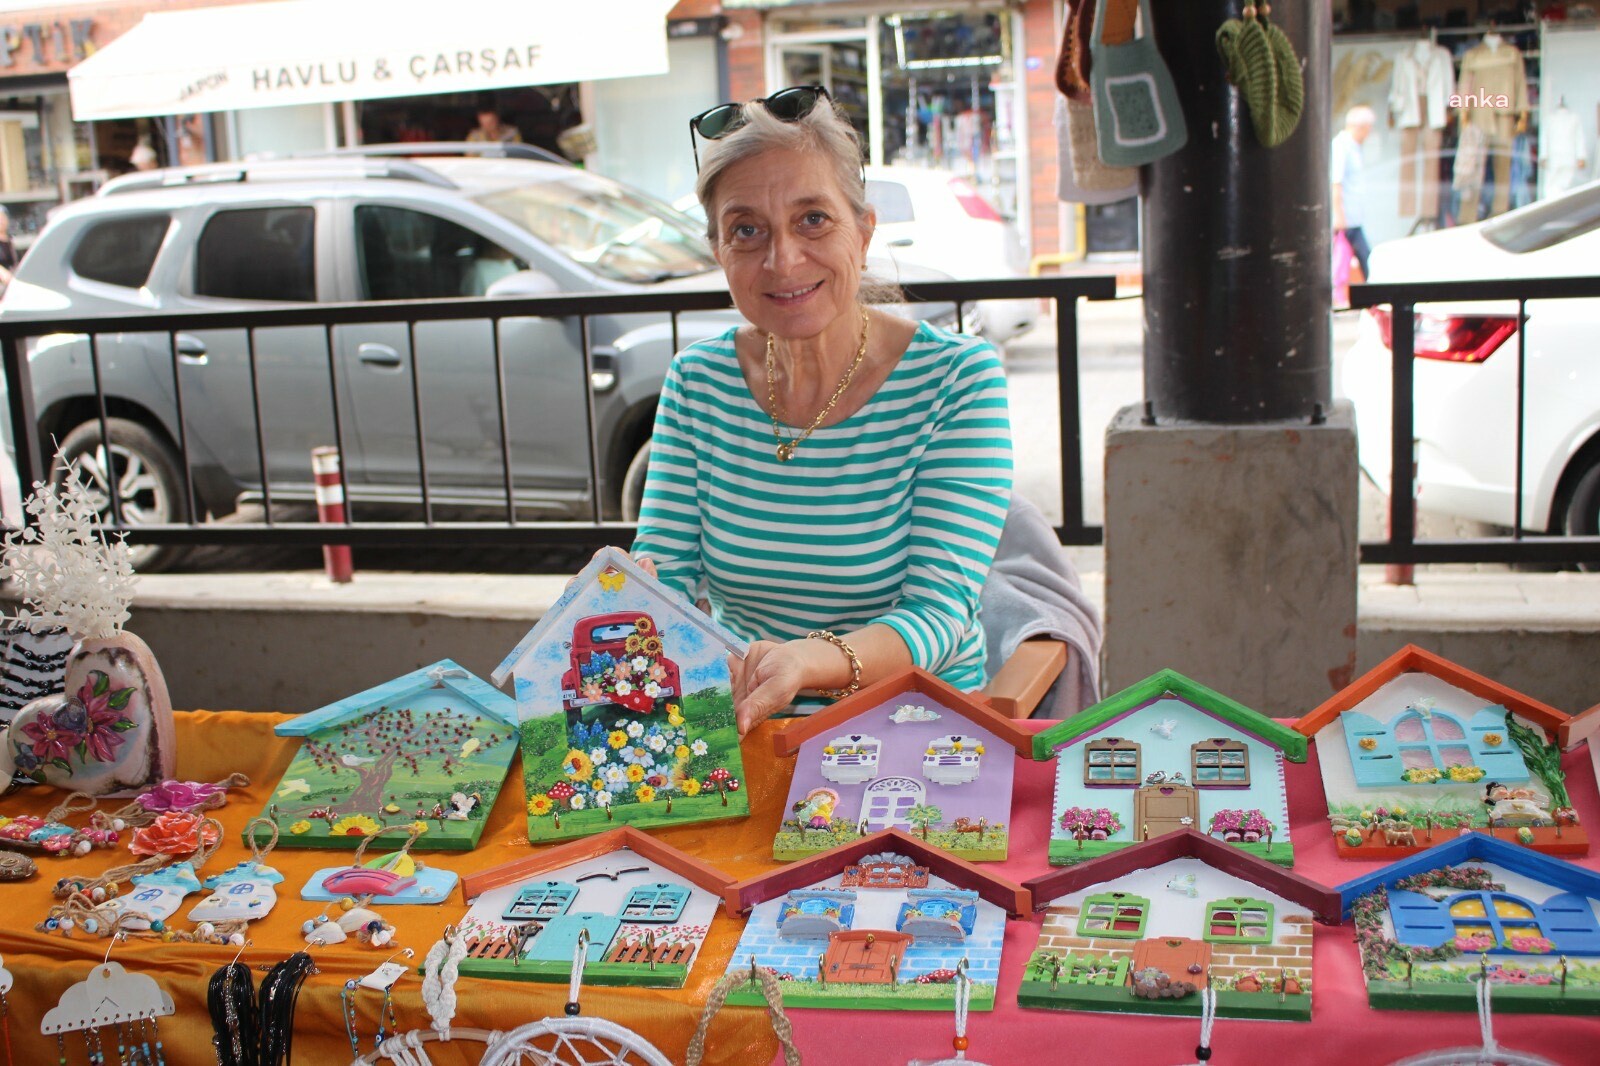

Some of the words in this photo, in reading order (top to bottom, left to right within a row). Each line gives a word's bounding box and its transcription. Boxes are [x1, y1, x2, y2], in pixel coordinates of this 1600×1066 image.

[252, 60, 357, 91] HAVLU
[373, 57, 392, 81] &
[409, 44, 543, 82] ÇARŞAF
